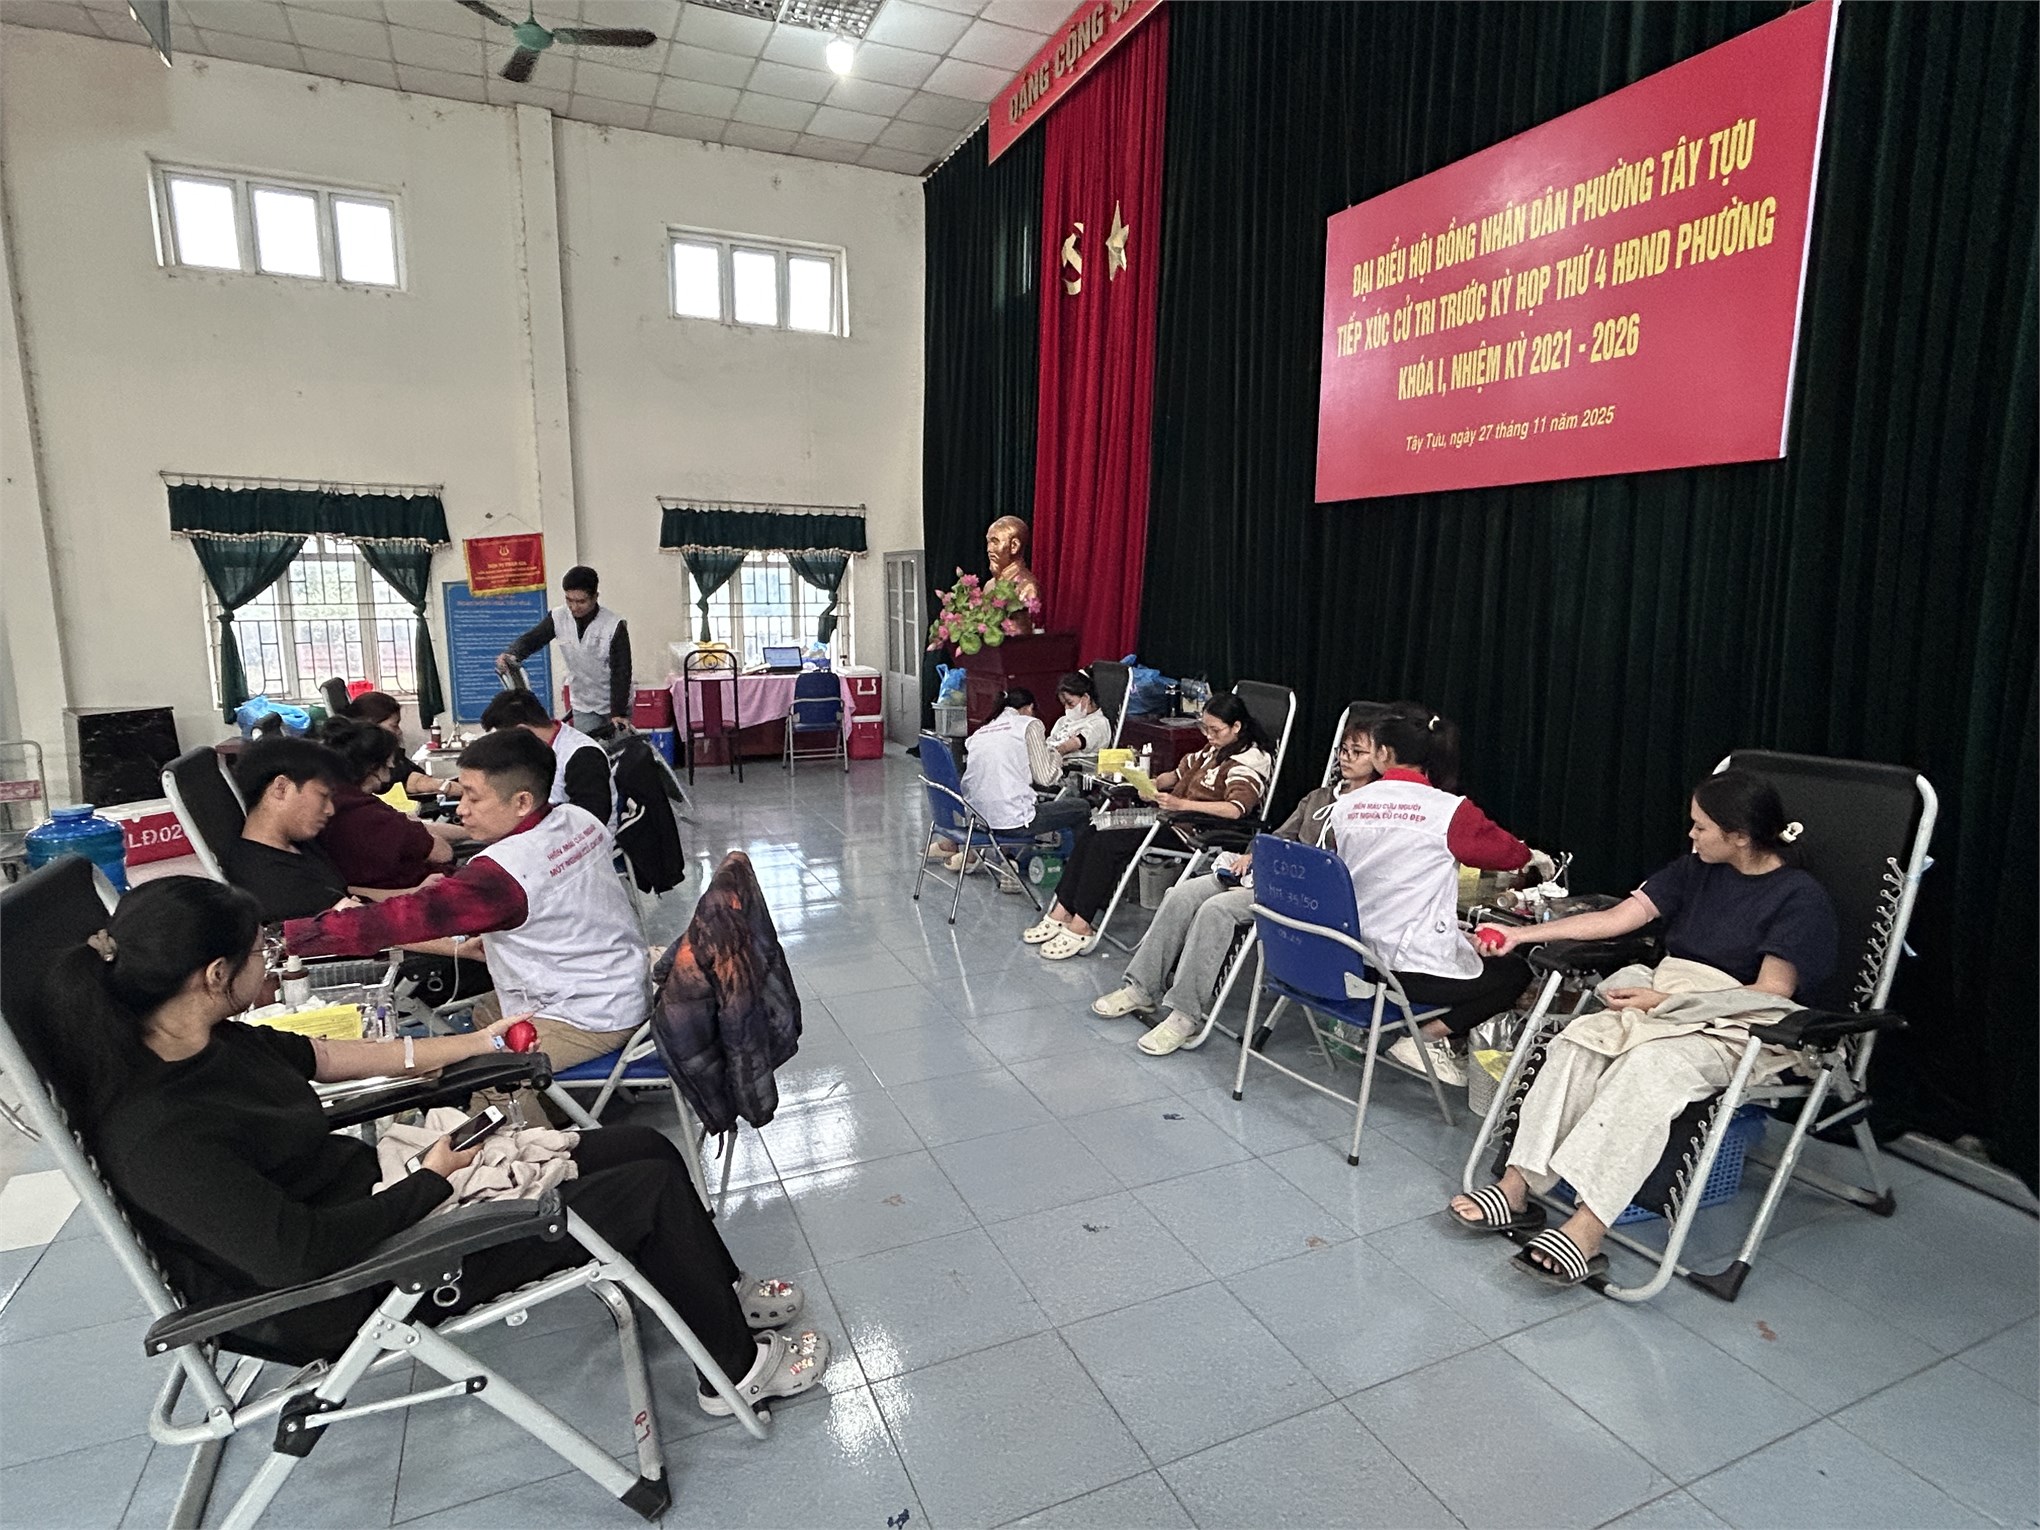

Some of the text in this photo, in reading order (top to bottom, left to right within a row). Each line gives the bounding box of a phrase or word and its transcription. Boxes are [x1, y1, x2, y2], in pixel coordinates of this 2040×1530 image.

[1055, 2, 1104, 79] CỘNG
[1352, 117, 1757, 303] ĐẠI BIỂU HỘI ĐỒNG NHÂN DÂN PHƯỜNG TÂY TỰU
[1337, 195, 1777, 358] TIẾP XÚC CỬ TRI TRƯỚC KỲ HỌP THỨ 4 HĐND PHƯỜNG
[1398, 312, 1641, 401] KHÓA I, NHIỆM KỲ 2021 - 2026
[1406, 404, 1616, 454] Tây Tựu, ngày 27 tháng 11 năm 2025
